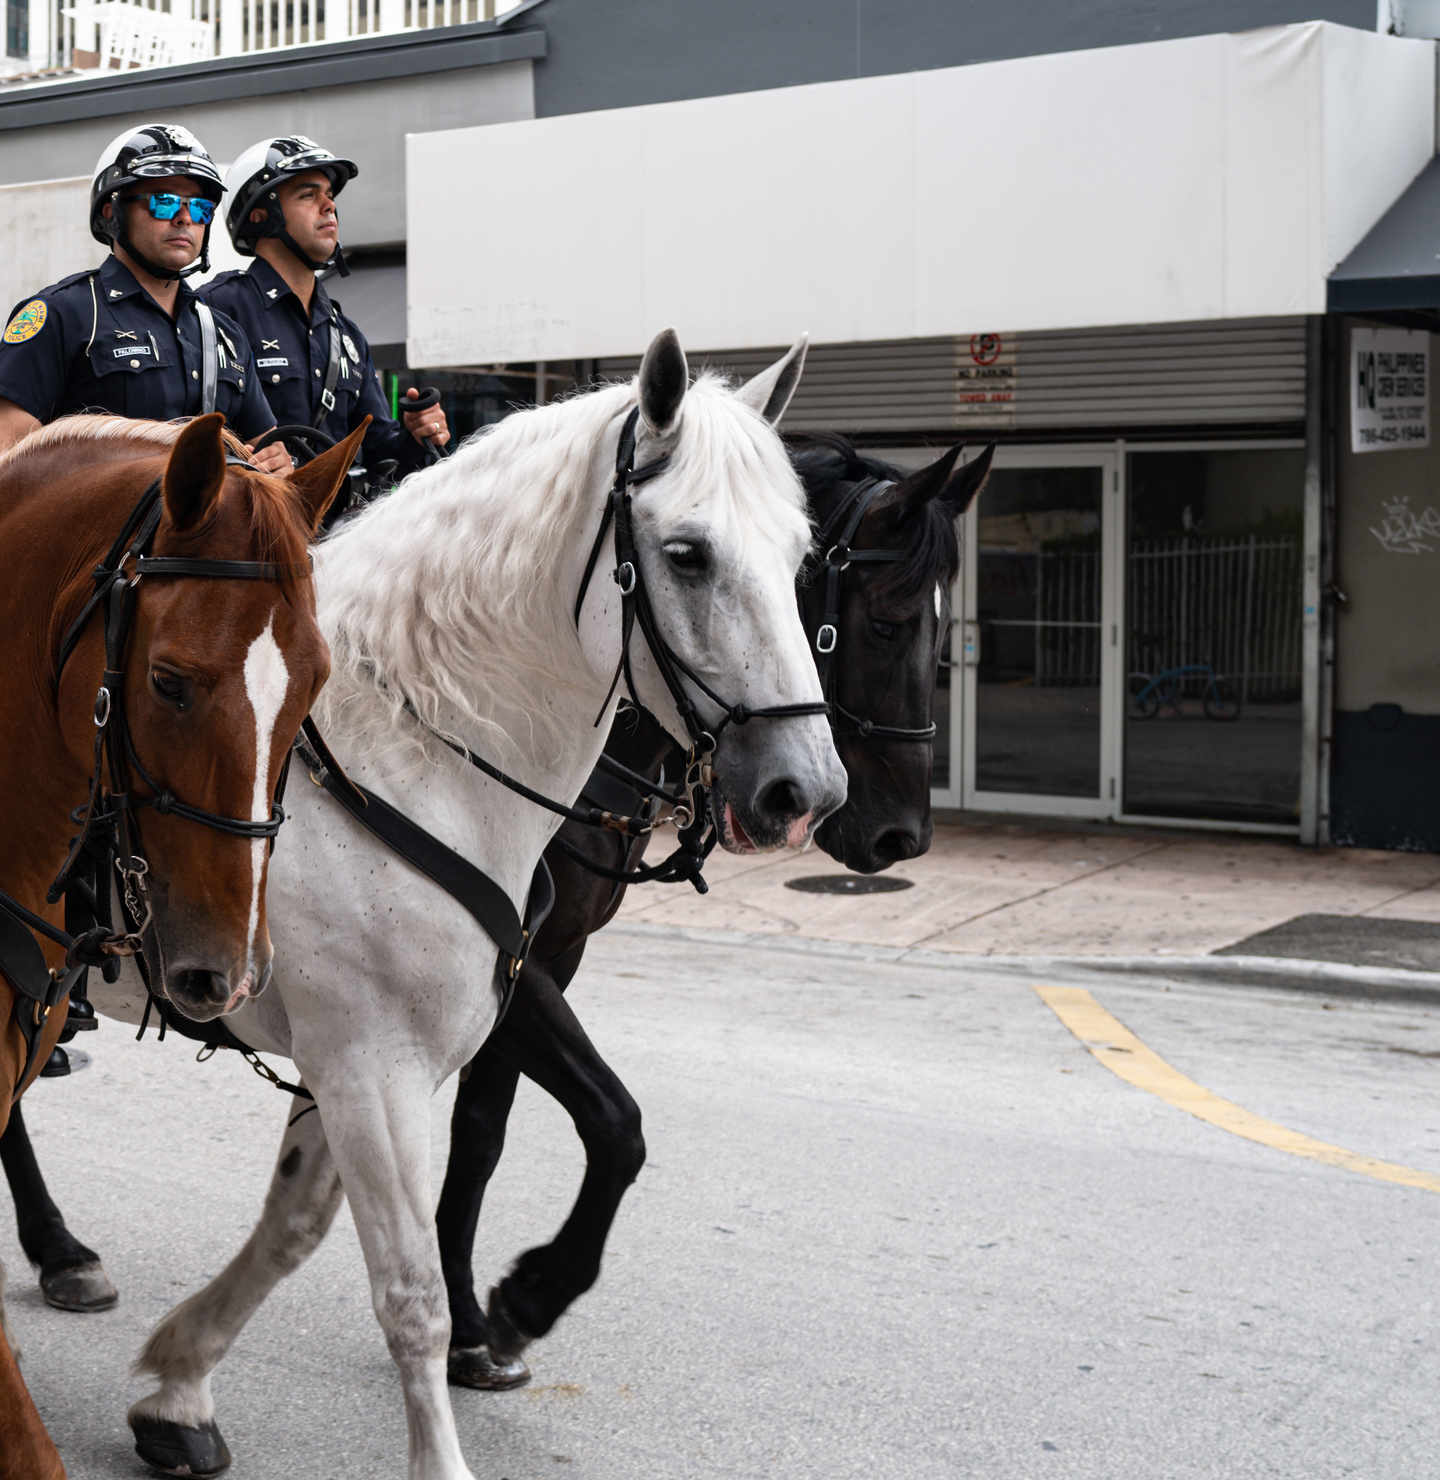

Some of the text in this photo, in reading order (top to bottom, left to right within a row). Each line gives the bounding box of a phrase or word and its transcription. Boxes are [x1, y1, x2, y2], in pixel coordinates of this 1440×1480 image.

[958, 366, 1014, 379] NO PARKING
[1357, 351, 1426, 411] HQ PHILIPPINES
[1396, 376, 1426, 397] SERVICES
[959, 392, 1013, 403] TOWED AWAY
[1359, 425, 1426, 444] 786-425-1944
